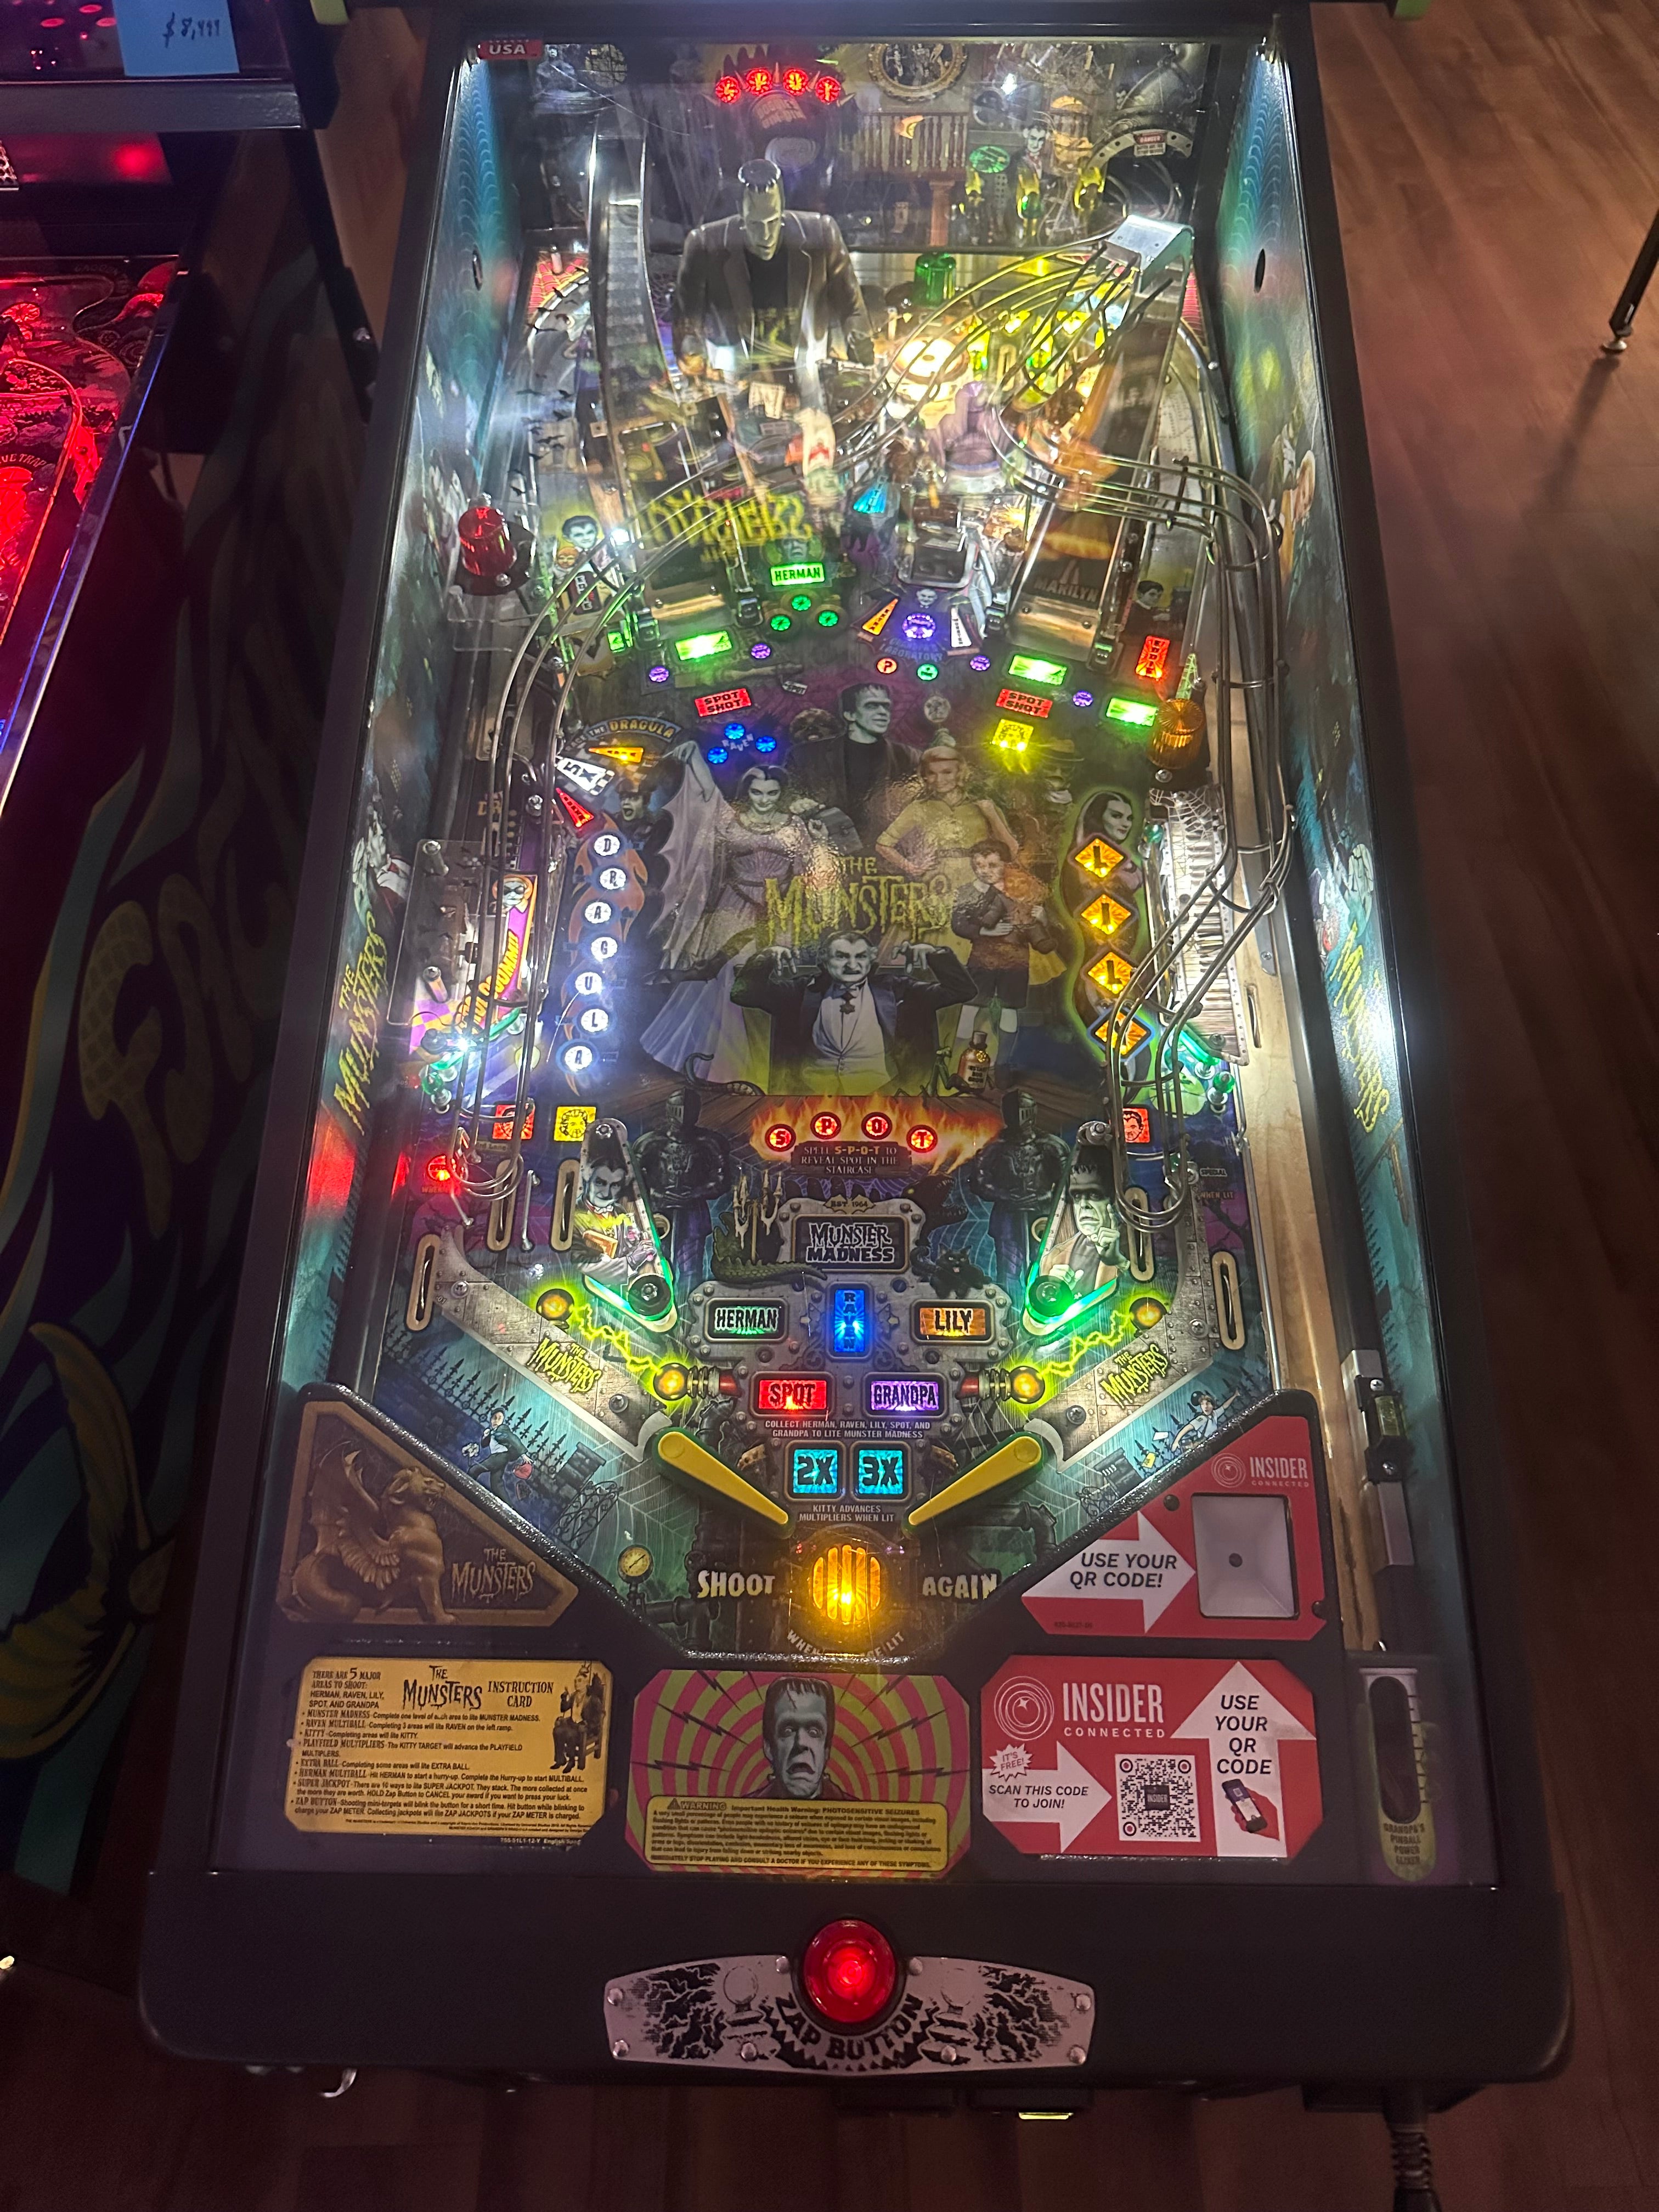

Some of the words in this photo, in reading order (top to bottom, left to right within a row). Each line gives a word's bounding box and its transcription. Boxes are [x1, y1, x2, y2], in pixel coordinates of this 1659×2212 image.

[489, 44, 525, 54] USA
[19, 453, 47, 467] TRAP
[774, 568, 821, 581] HERMAN
[1034, 578, 1098, 602] MARILYN
[879, 644, 944, 662] LABORATORY
[1146, 640, 1161, 674] EDDIE
[704, 691, 739, 704] SPOT
[707, 699, 742, 713] SHOT
[1008, 692, 1045, 706] SPOT
[1005, 701, 1042, 714] SHOT
[589, 727, 605, 736] THE
[609, 719, 675, 738] DRAGULA
[721, 733, 754, 751] RAVEN
[564, 761, 597, 783] 5X
[838, 856, 877, 874] THE
[765, 873, 954, 946] MUNSTERS
[338, 963, 356, 1010] THE
[334, 910, 388, 1136] MUNSTERS
[804, 1147, 829, 1155] SPELL
[834, 1147, 879, 1155] S-P-O-T
[802, 1156, 835, 1164] REVEAL
[809, 1222, 893, 1249] MUNSTER
[805, 1245, 895, 1262] MADNESS
[715, 1308, 779, 1330] HERMAN
[843, 1292, 855, 1350] RAVEN
[934, 1308, 973, 1333] LILY
[570, 1343, 586, 1358] THE
[1114, 1351, 1132, 1365] THE
[527, 1338, 601, 1392] MUNSTERS
[1099, 1344, 1168, 1408] MUNSTERS
[770, 1384, 815, 1404] SPOT
[873, 1384, 936, 1406] GRANDPA
[797, 1456, 833, 1486] 2X
[862, 1457, 899, 1486] 3X
[1101, 1464, 1119, 1476] 1313
[1250, 1457, 1308, 1480] INSIDER
[1251, 1480, 1310, 1488] CONNECTED
[483, 1548, 507, 1563] THE
[1081, 1553, 1119, 1568] USE
[1125, 1554, 1178, 1570] YOUR
[450, 1561, 537, 1605] MUNSTERS
[697, 1570, 776, 1599] SHOOT
[922, 1573, 998, 1600] AGAIN
[1070, 1570, 1097, 1589] QR
[1103, 1571, 1164, 1588] CODE!
[887, 1632, 904, 1651] LIT
[313, 1671, 334, 1679] THERE
[336, 1671, 348, 1679] ARE
[349, 1668, 358, 1680] 5
[359, 1672, 381, 1680] MAJOR
[429, 1665, 448, 1679] THE
[312, 1680, 332, 1689] AREAS
[402, 1679, 482, 1711] MUNSTERS
[487, 1681, 554, 1694] INSTRUCTION
[507, 1695, 532, 1708] CARD
[1063, 1683, 1164, 1723] INSIDER
[1220, 1695, 1260, 1710] USE
[307, 1710, 338, 1718] MUNSTER
[340, 1711, 370, 1719] MADNESS
[306, 1719, 326, 1728] RAVEN
[329, 1720, 365, 1728] MULTIBALL
[1215, 1716, 1268, 1732] YOUR
[1064, 1726, 1165, 1739] CONNECTED
[303, 1739, 338, 1747] PLAYFIELD
[340, 1740, 385, 1749] MULTIPLIERS
[1228, 1737, 1256, 1756] QR
[1000, 1757, 1025, 1770] FREE!
[1001, 1751, 1018, 1763] IT'S
[1216, 1758, 1273, 1775] CODE
[989, 1784, 1021, 1796] SCAN
[1025, 1785, 1052, 1796] THIS
[1056, 1785, 1088, 1797] CODE
[1147, 1793, 1169, 1804] INSIDER
[311, 1797, 337, 1806] BUTTON
[681, 1801, 726, 1810] WARNING
[1013, 1797, 1029, 1809] TO
[1032, 1797, 1065, 1809] JOIN!
[775, 1992, 821, 2045] ZAP
[826, 1993, 923, 2060] BUTTON
